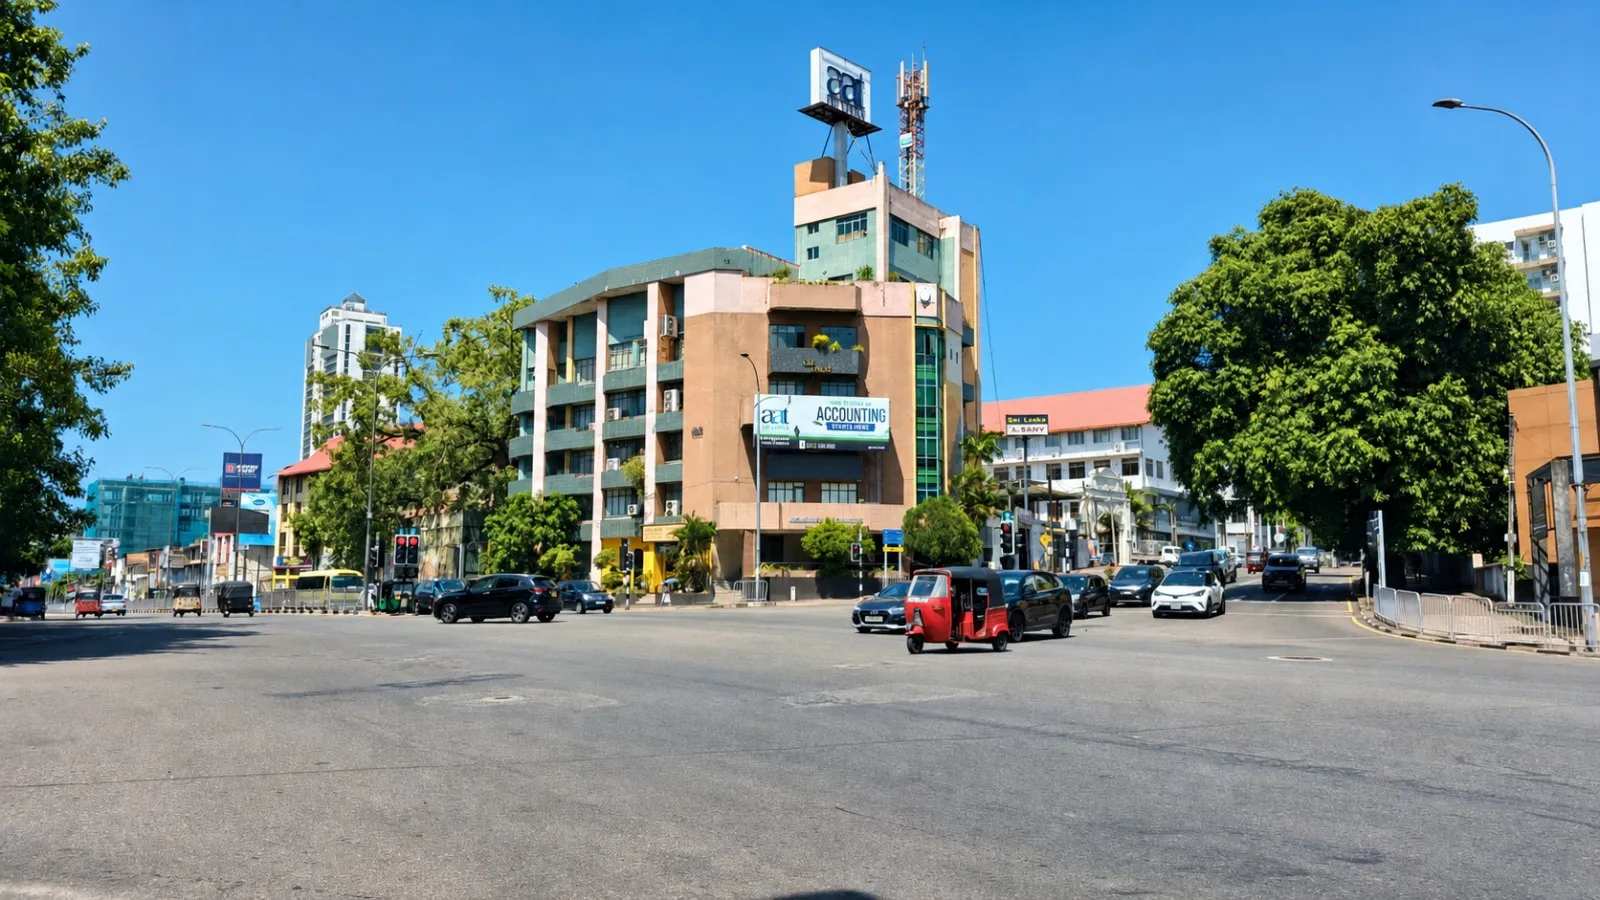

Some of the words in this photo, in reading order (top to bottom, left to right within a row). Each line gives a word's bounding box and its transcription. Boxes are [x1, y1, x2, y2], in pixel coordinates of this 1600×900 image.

[827, 66, 865, 107] aat
[761, 407, 789, 424] aat
[816, 406, 886, 423] ACCOUNTING
